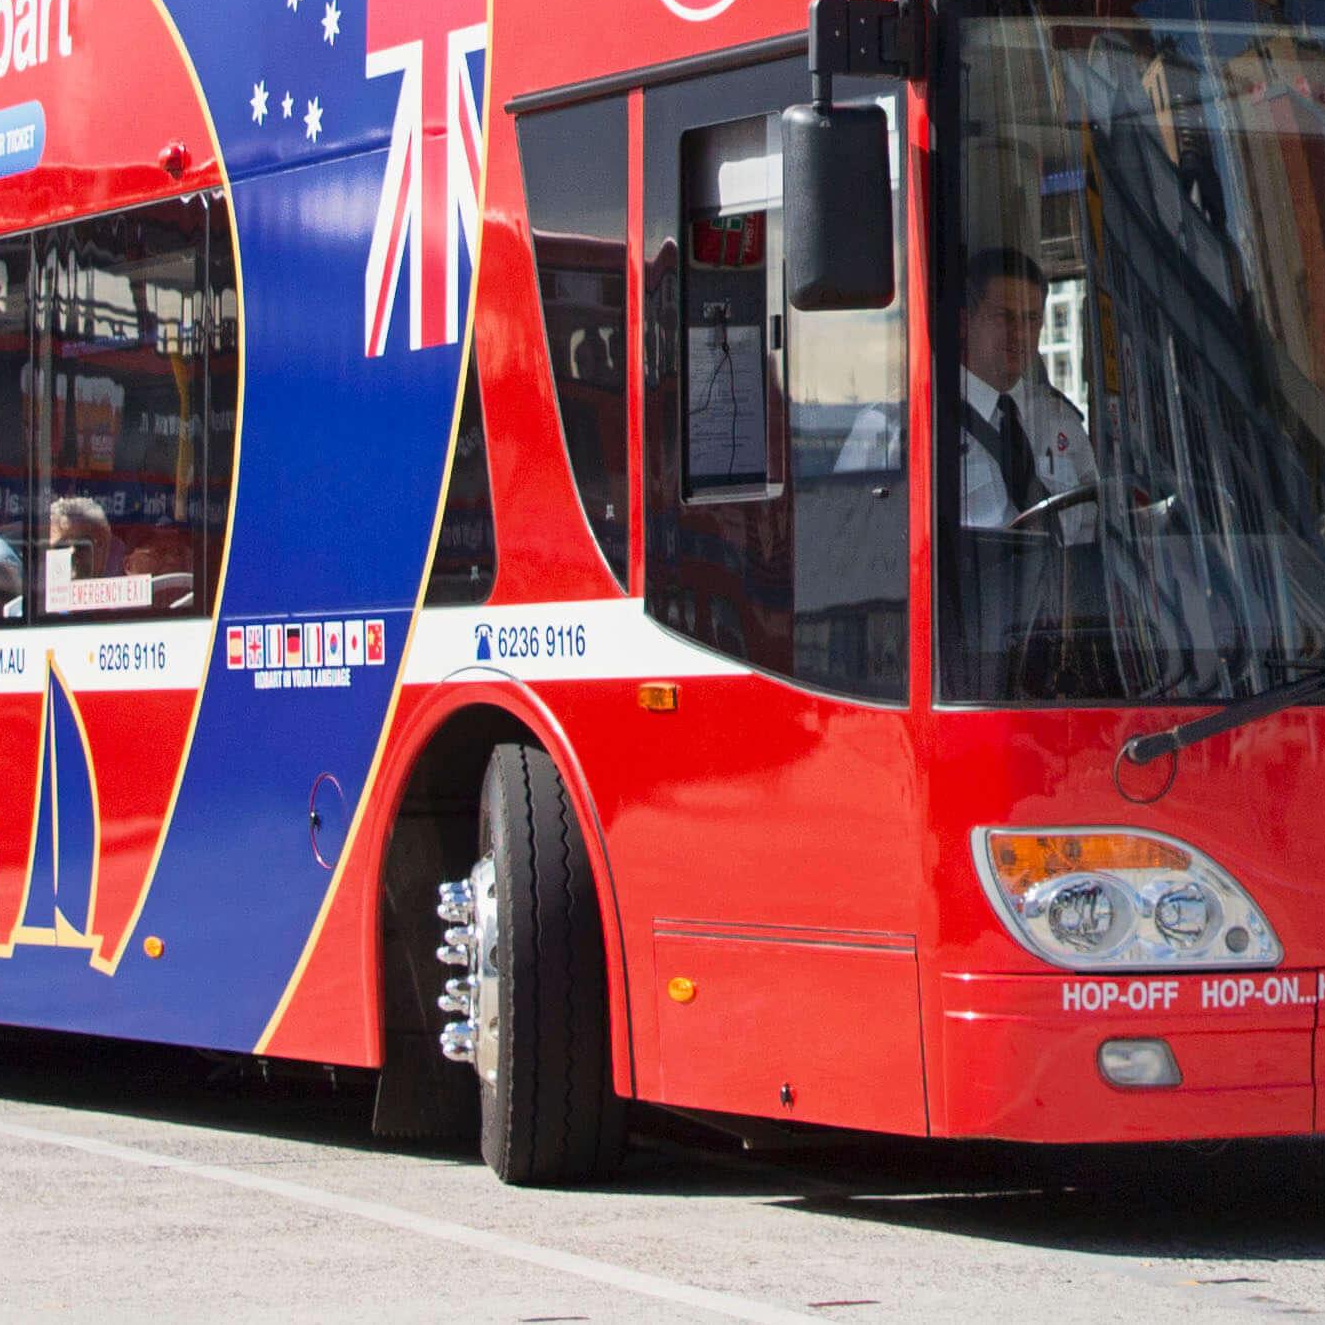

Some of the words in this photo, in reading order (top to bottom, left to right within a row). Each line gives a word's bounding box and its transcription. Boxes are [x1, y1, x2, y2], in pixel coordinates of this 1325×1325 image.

[98, 643, 130, 672] 6236
[134, 641, 166, 671] 9116
[498, 626, 540, 659] 6236
[545, 624, 586, 657] 9116
[1062, 981, 1179, 1011] HOP-OFF
